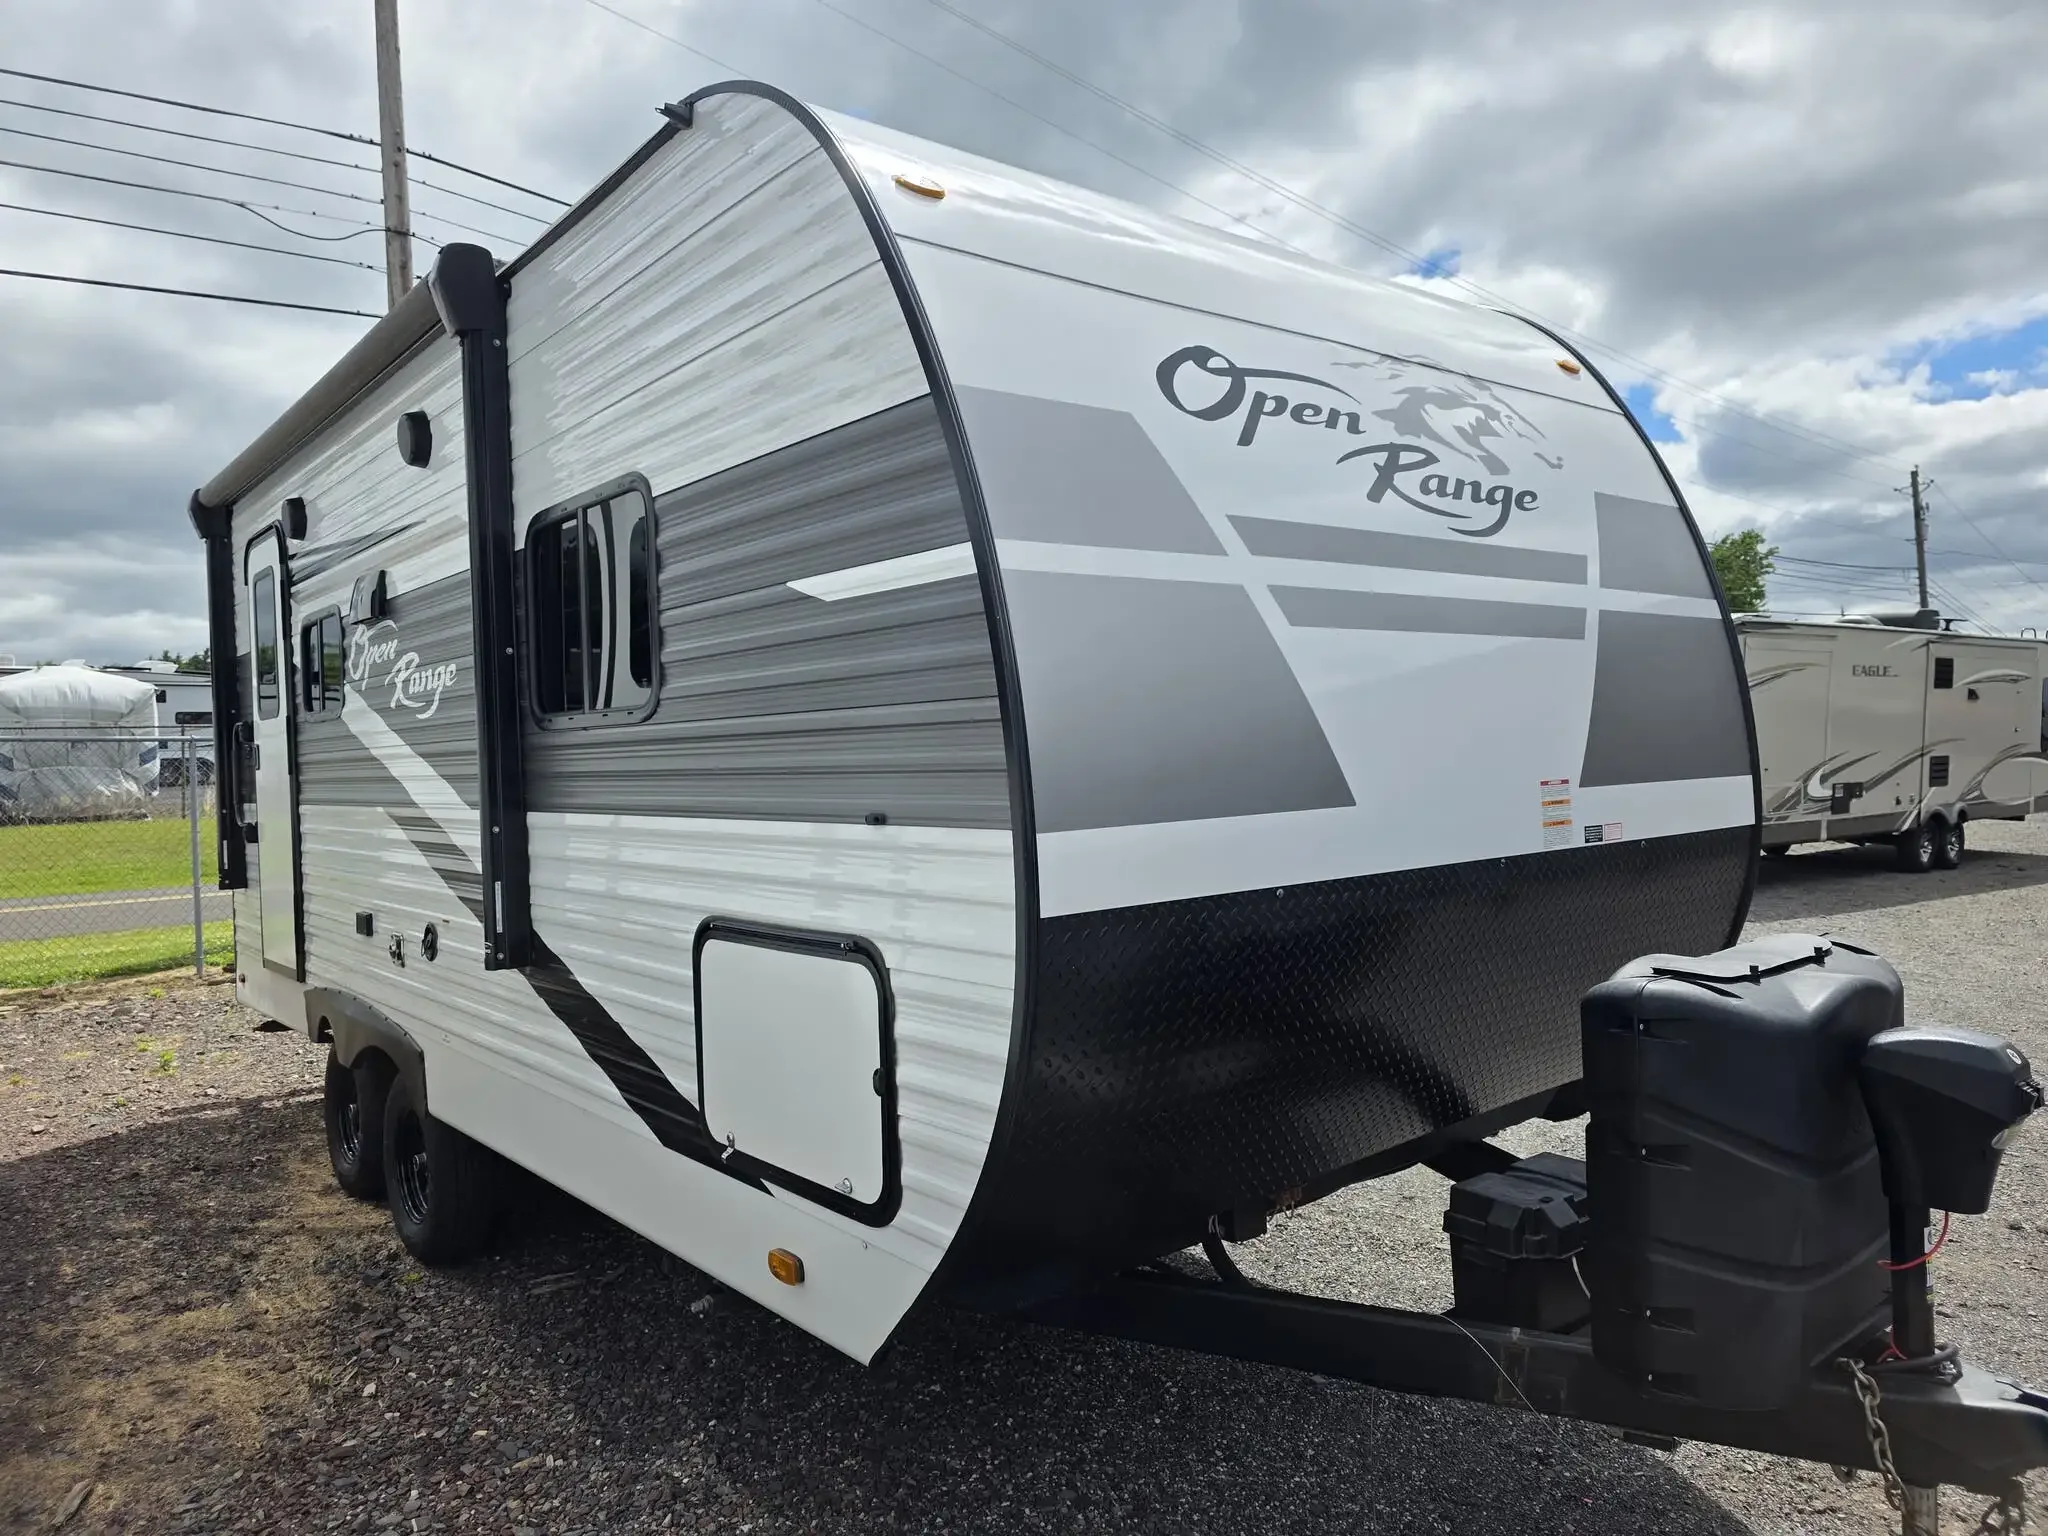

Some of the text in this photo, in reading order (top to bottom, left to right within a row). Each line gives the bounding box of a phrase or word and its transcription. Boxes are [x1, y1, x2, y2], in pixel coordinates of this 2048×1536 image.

[1155, 345, 1366, 447] Open
[1336, 442, 1540, 538] Range
[350, 619, 399, 691] Open
[385, 651, 458, 719] Range
[1852, 664, 1892, 677] EAGLE
